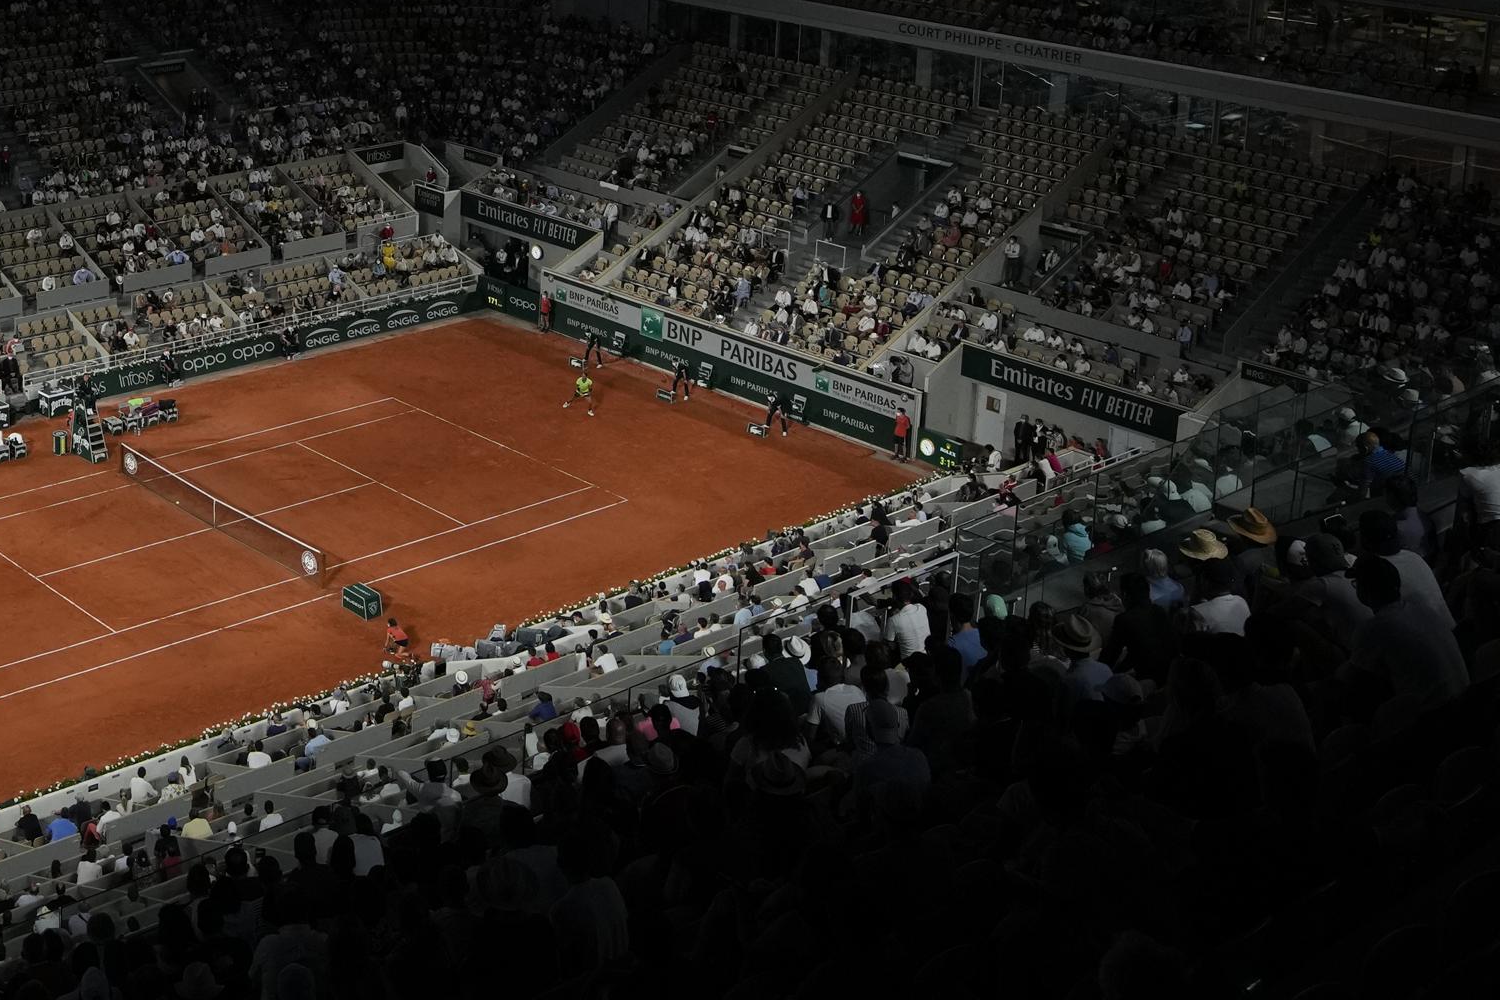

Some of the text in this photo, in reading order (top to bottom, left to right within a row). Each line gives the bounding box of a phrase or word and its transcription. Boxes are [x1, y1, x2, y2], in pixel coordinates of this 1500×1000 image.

[897, 23, 941, 40] COURT
[945, 30, 1002, 50] PHILIPPE
[1014, 42, 1082, 65] CHATRIER
[478, 200, 578, 246] Emirates FLY BETTER
[487, 296, 498, 306] 171
[509, 296, 537, 311] oppo
[569, 290, 585, 303] BNP
[586, 296, 619, 316] PARIBAS
[566, 317, 580, 328] BNP
[233, 341, 275, 360] oppo
[645, 345, 660, 356] BNP
[666, 321, 798, 382] BNP PARIBAS
[182, 352, 226, 372] oppo
[118, 370, 155, 388] Infosys
[730, 376, 746, 387] BNP
[832, 380, 853, 393] BNP
[854, 388, 897, 410] PARIBAS
[991, 358, 1154, 427] Emirates FLY BETTER
[823, 408, 876, 433] BNP PARIBAS
